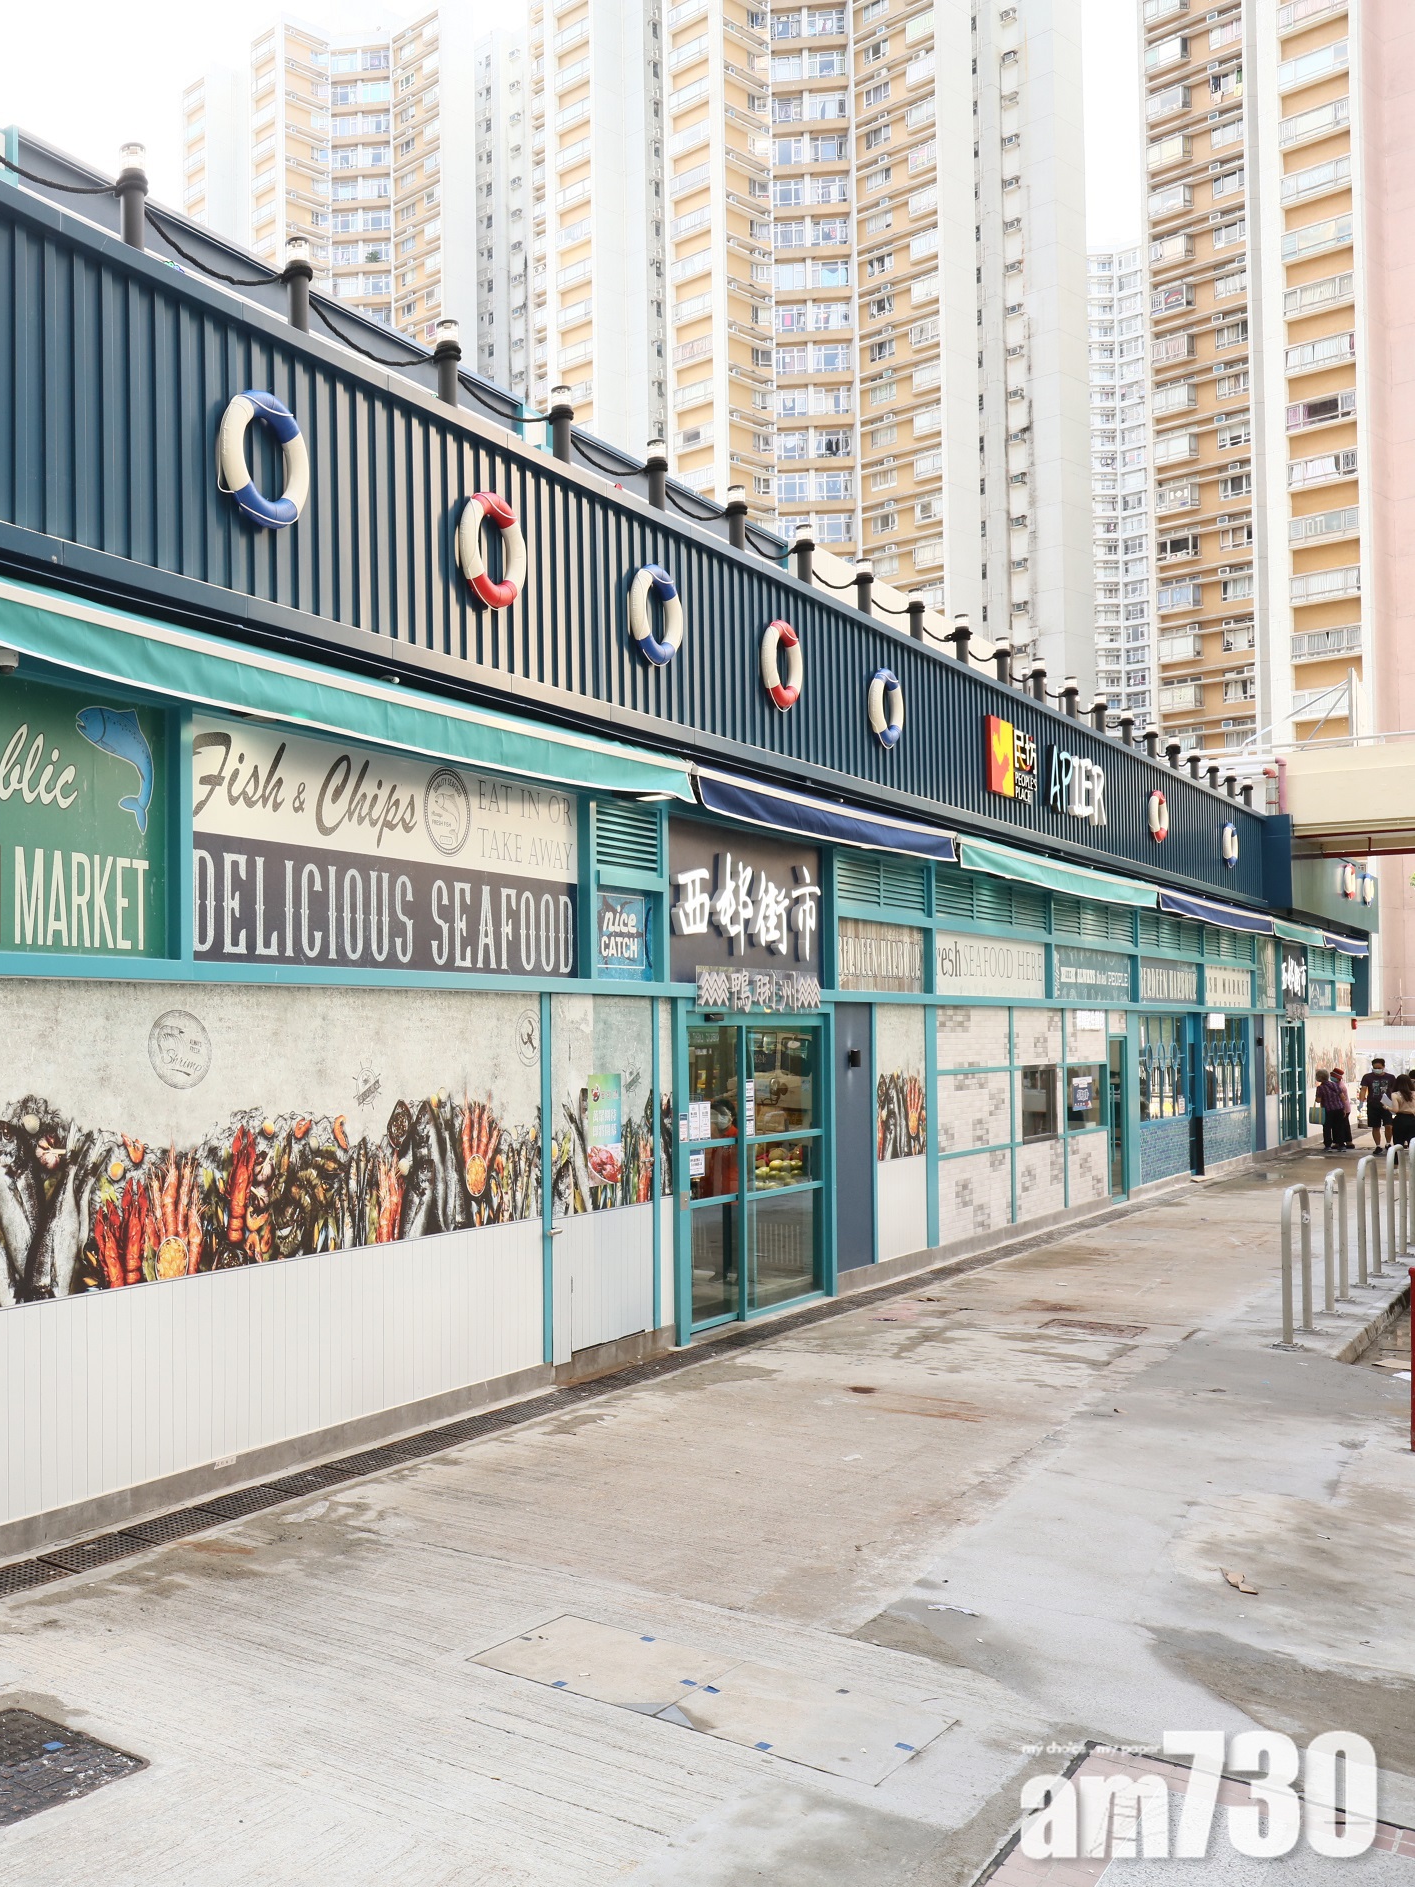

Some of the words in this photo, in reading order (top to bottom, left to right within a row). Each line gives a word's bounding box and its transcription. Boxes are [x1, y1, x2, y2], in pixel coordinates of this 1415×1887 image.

[192, 731, 286, 818] Fish
[292, 781, 306, 813] &
[314, 754, 418, 848] Chips
[477, 779, 512, 815] EAT
[520, 788, 541, 820] IN
[548, 795, 573, 827] OR
[1015, 785, 1031, 803] PLACE
[1049, 744, 1106, 826] APIER
[477, 827, 523, 863] TAKE
[528, 836, 573, 870] AWAY
[14, 846, 150, 951] MARKET
[192, 848, 414, 963] DELICIOUS
[430, 879, 573, 974] SEAFOOD
[602, 904, 637, 934] nice
[675, 852, 822, 962] 西邨街市
[600, 935, 638, 959] CATCH
[963, 944, 1014, 979] SEAFOOD
[1017, 950, 1043, 982] HERE
[1108, 971, 1128, 987] PEOPLE
[161, 1048, 203, 1075] Shrimp
